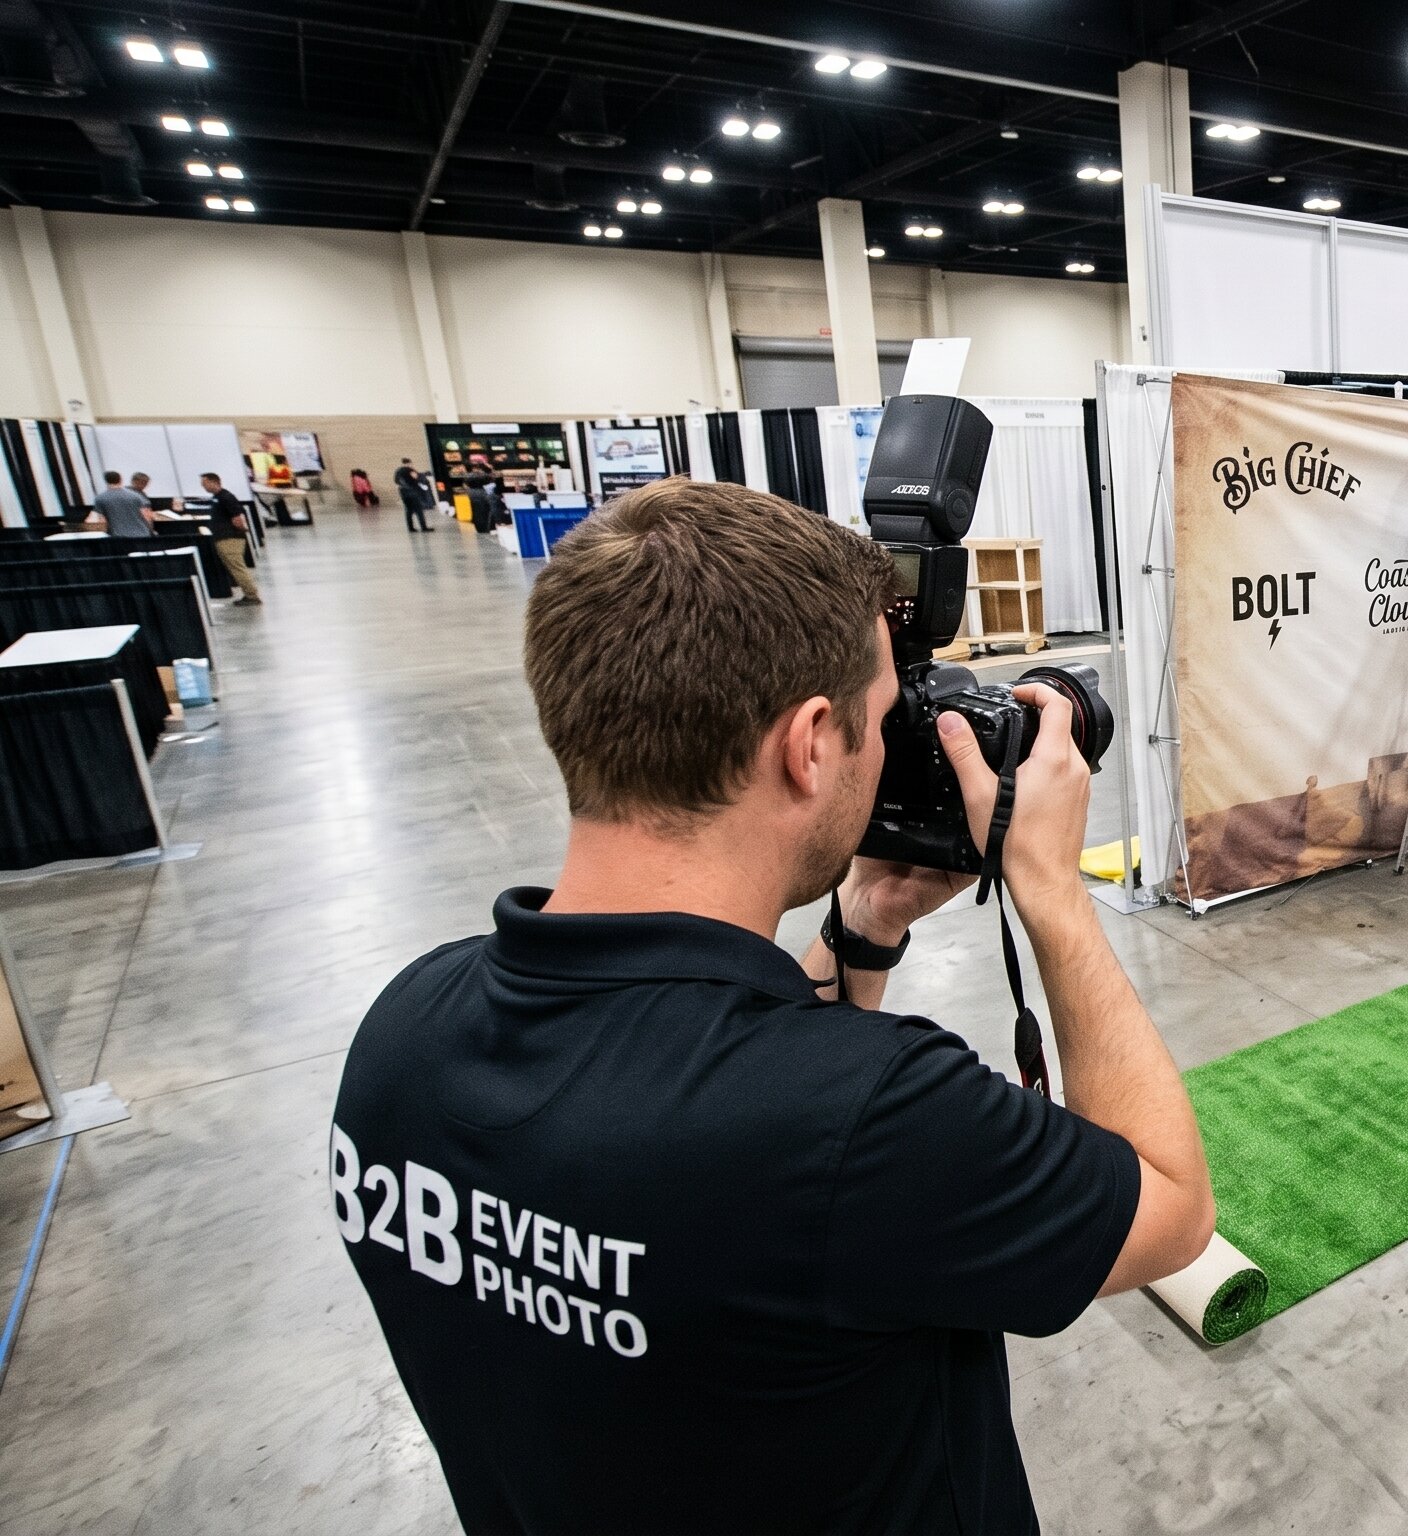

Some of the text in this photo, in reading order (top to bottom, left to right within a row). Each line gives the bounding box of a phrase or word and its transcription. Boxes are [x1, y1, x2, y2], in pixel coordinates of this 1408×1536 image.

[1232, 572, 1316, 621] BOLT
[331, 1122, 646, 1297] B2B EVENT
[473, 1253, 648, 1358] PHOTO
